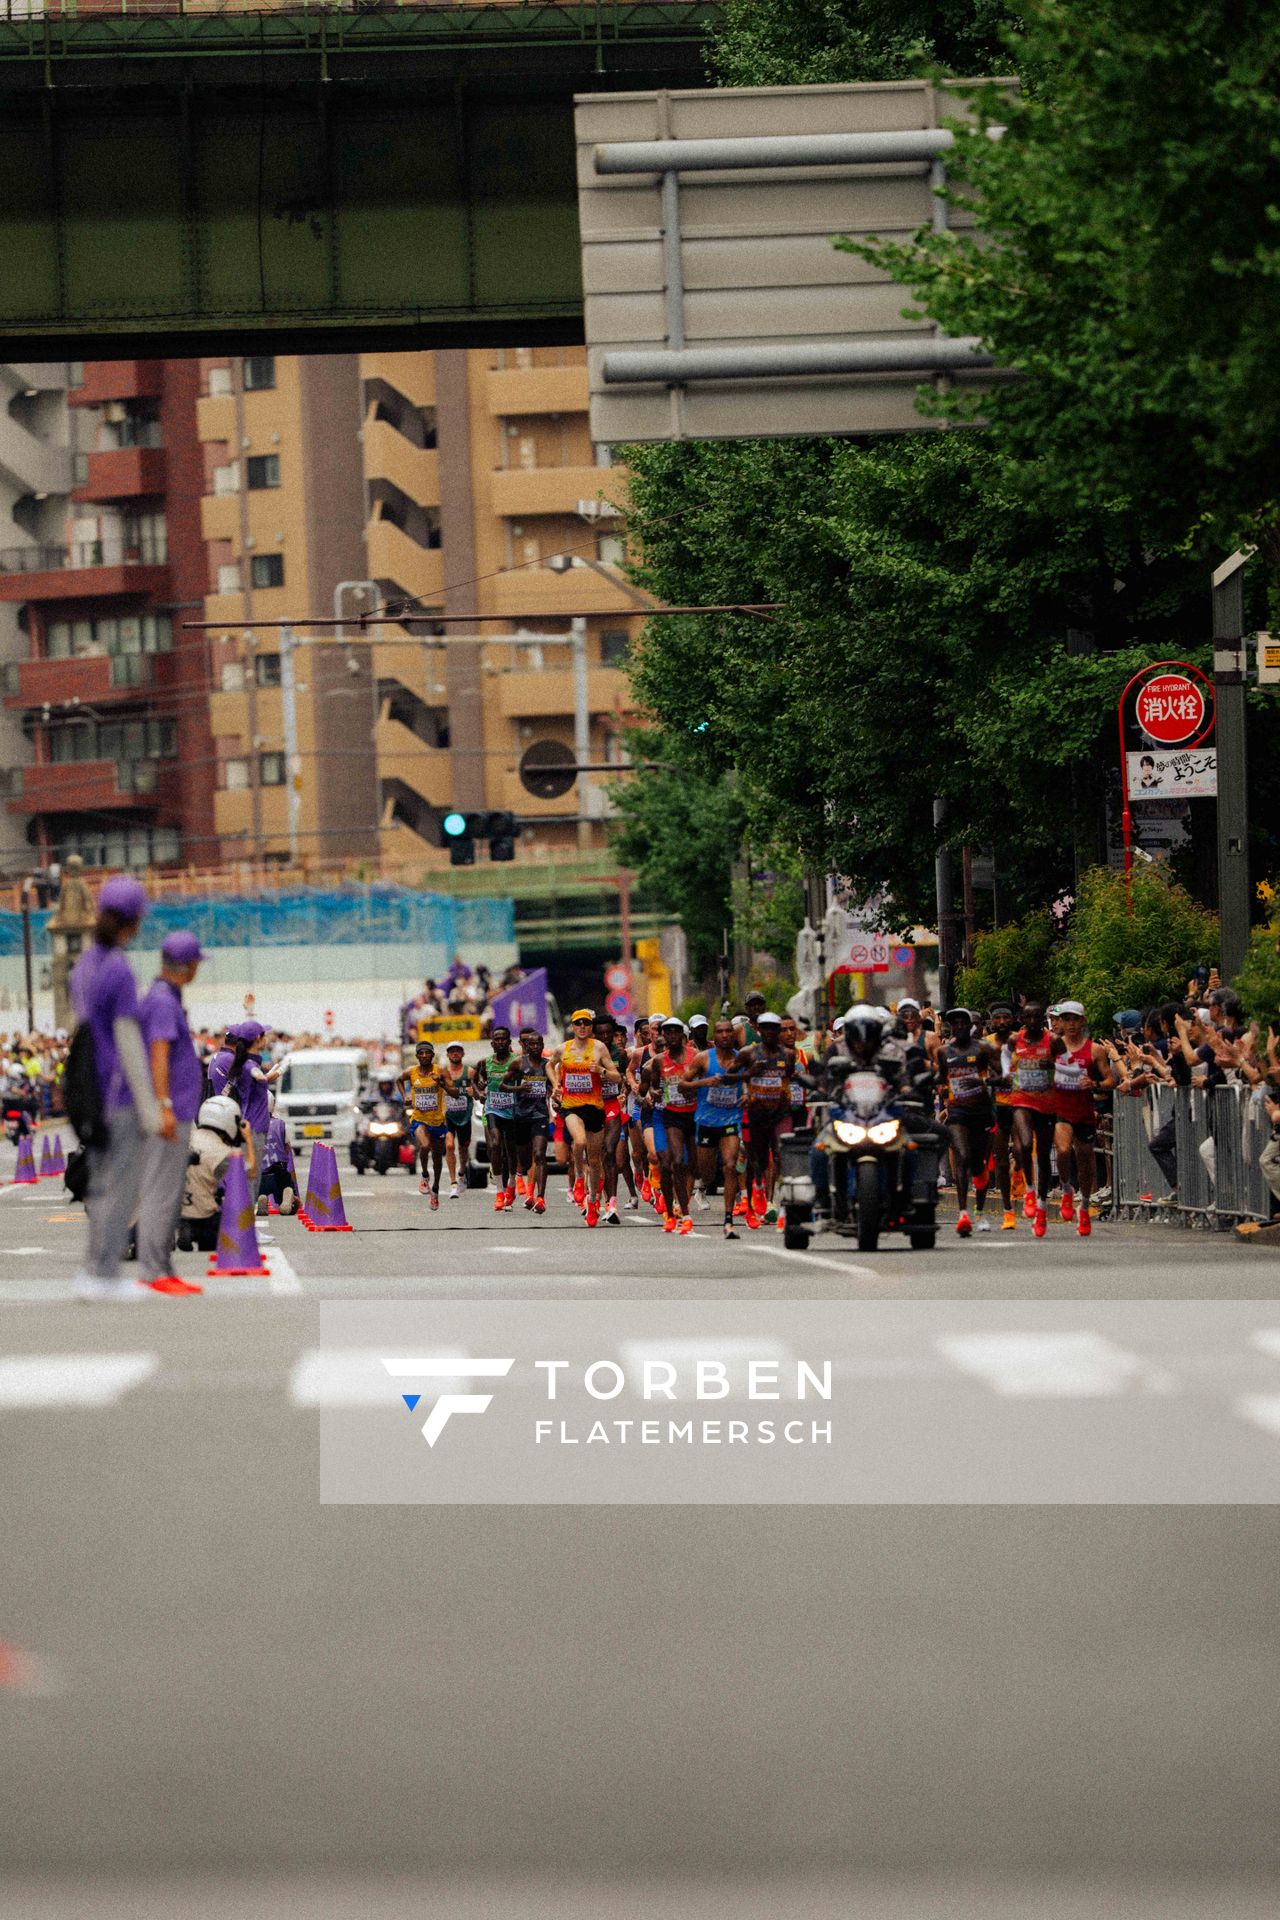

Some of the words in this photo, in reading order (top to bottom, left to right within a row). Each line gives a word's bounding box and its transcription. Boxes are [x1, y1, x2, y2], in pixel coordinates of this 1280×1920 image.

[1147, 684, 1161, 693] FIRE
[1162, 683, 1191, 692] HYDRANT
[1143, 694, 1198, 723] 消火栓
[1174, 756, 1217, 781] ようこそ
